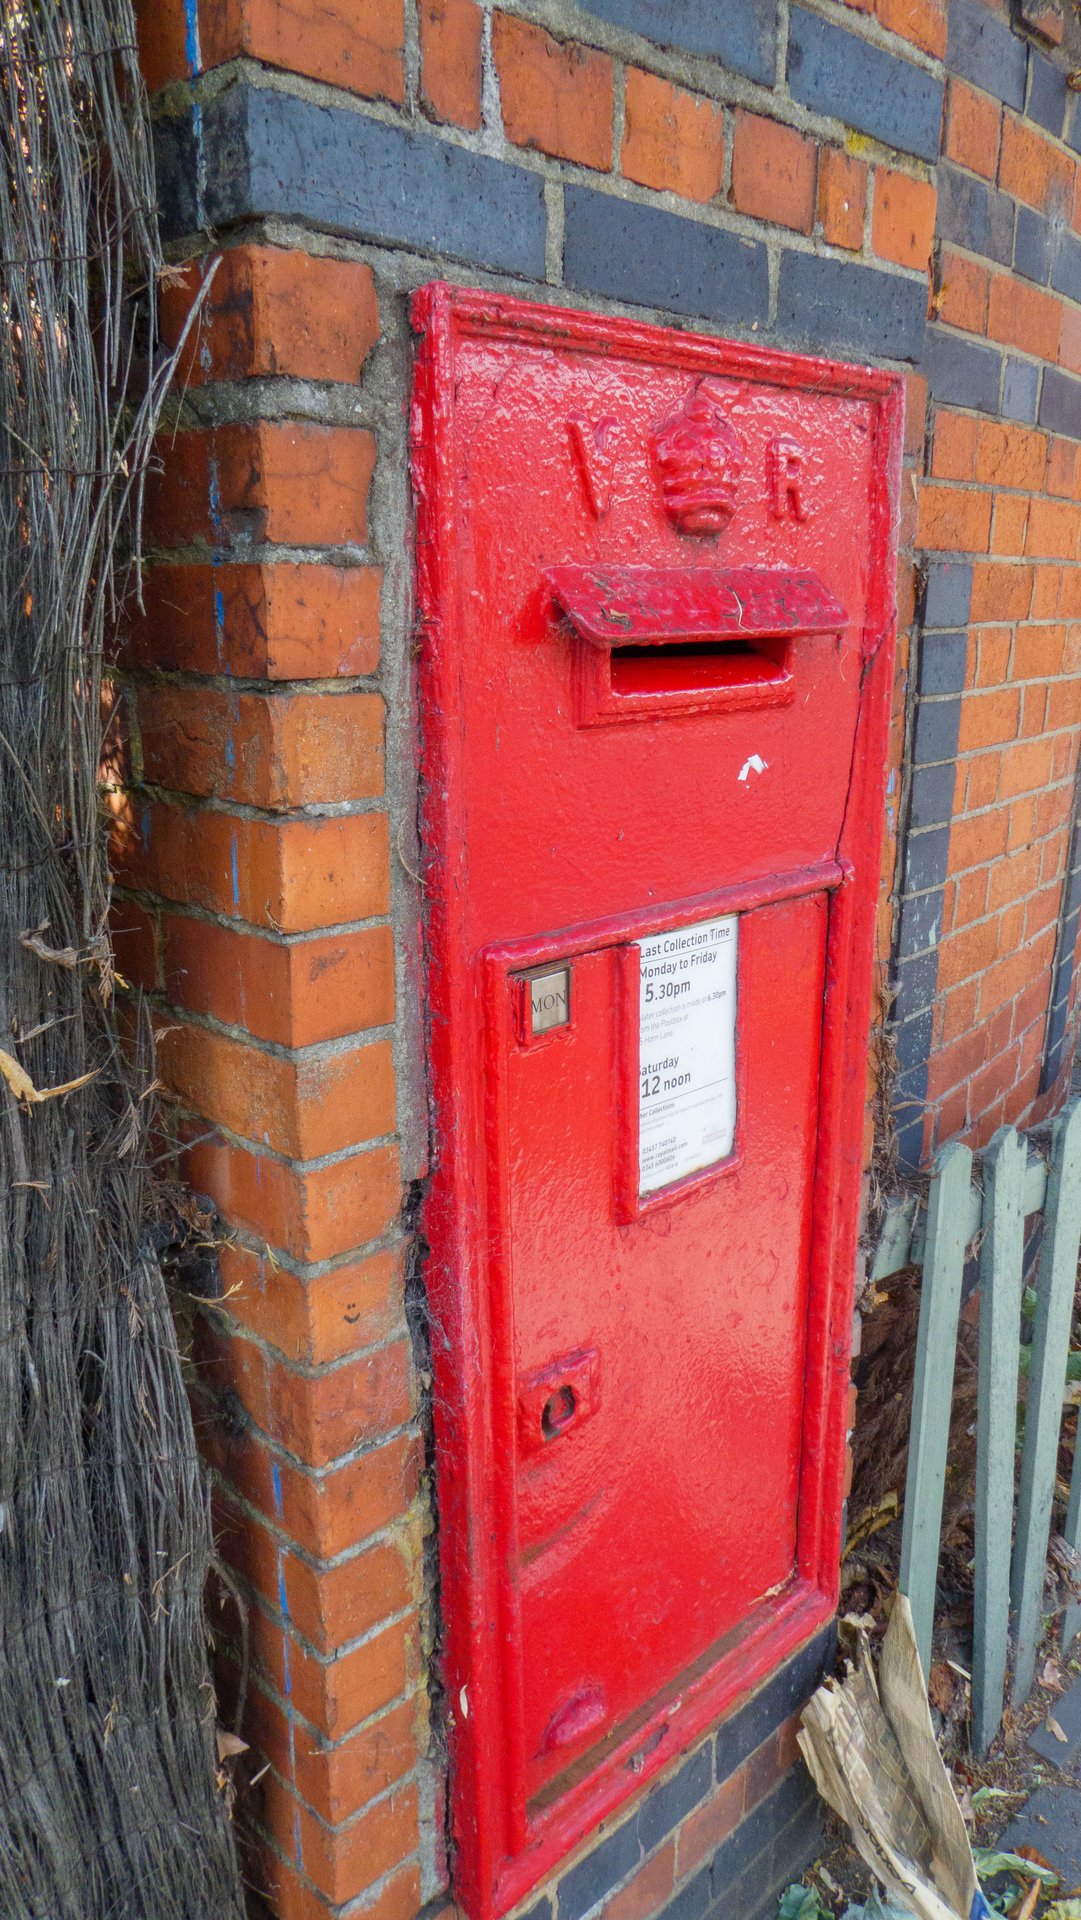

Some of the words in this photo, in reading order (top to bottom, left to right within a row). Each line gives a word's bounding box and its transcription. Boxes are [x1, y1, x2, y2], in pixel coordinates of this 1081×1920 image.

[765, 433, 808, 523] R
[640, 944, 662, 958] Last
[664, 932, 708, 953] Collection
[710, 927, 730, 940] Time
[640, 962, 677, 979] Monday
[679, 960, 689, 970] to
[691, 950, 717, 967] Friday
[532, 989, 567, 1014] MON
[645, 980, 691, 1003] 5.30pm
[640, 1056, 679, 1076] aturday
[641, 1074, 660, 1098] 12
[664, 1073, 691, 1091] noon
[649, 1103, 675, 1116] Collections
